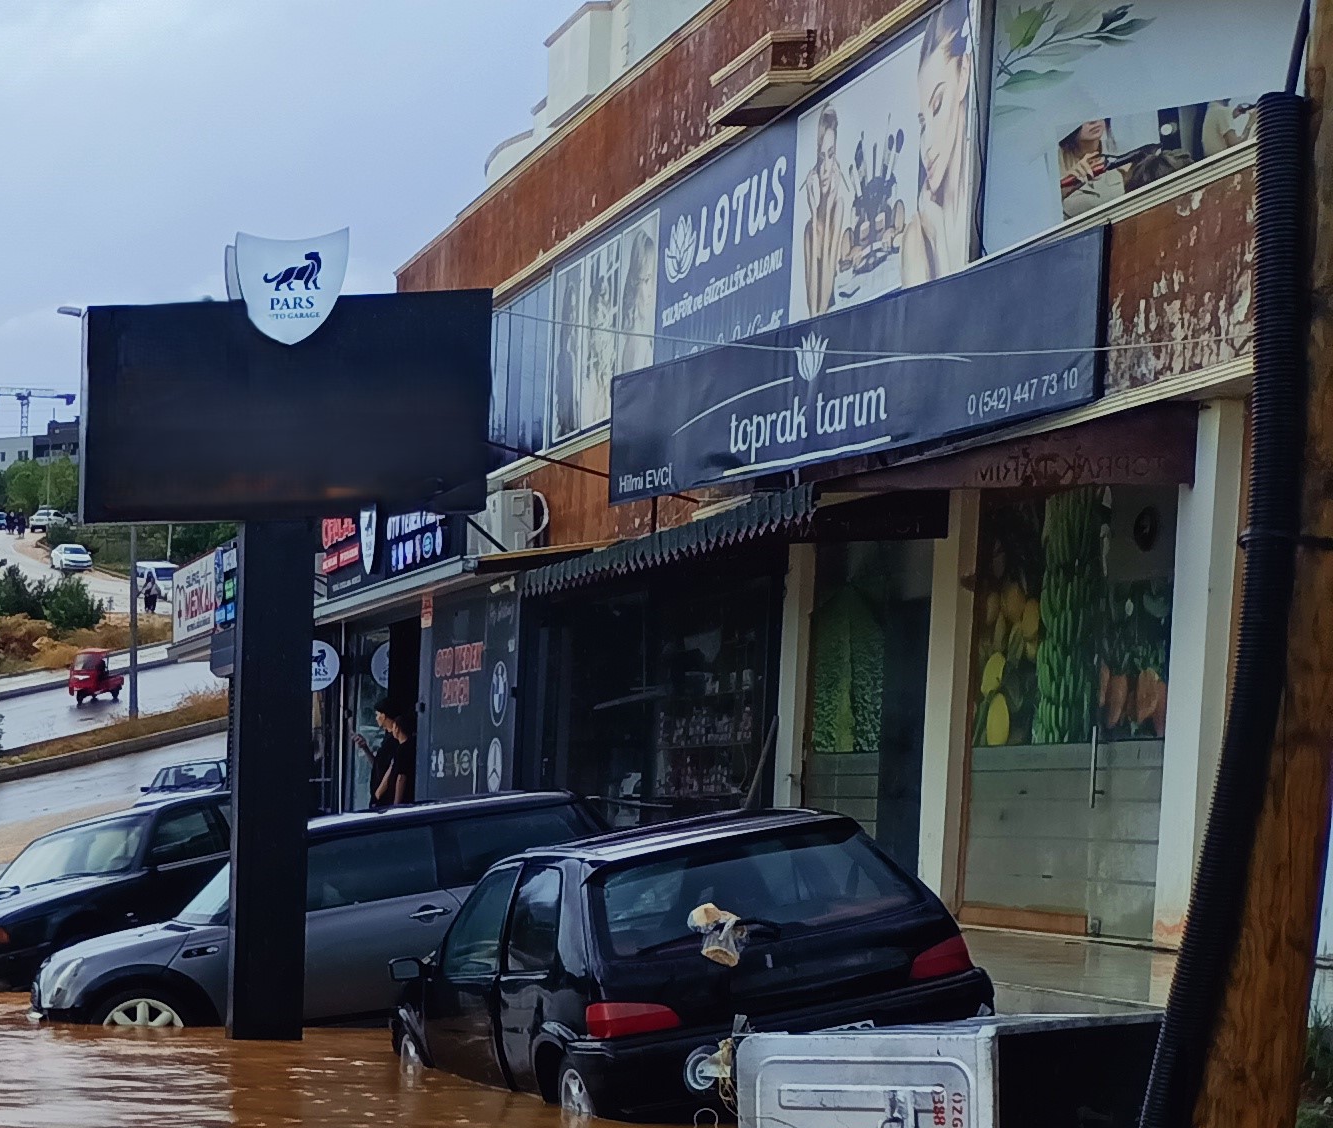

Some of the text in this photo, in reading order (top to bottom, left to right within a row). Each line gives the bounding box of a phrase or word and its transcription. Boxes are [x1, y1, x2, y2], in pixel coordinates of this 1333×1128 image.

[695, 156, 787, 266] LOTUS
[270, 296, 315, 310] PARS
[693, 294, 703, 310] ve
[703, 264, 746, 306] GÜZELLİK
[746, 248, 783, 285] SALONU
[967, 367, 1079, 418] 0 (542) 447 73 10
[730, 386, 887, 463] toprak tarım
